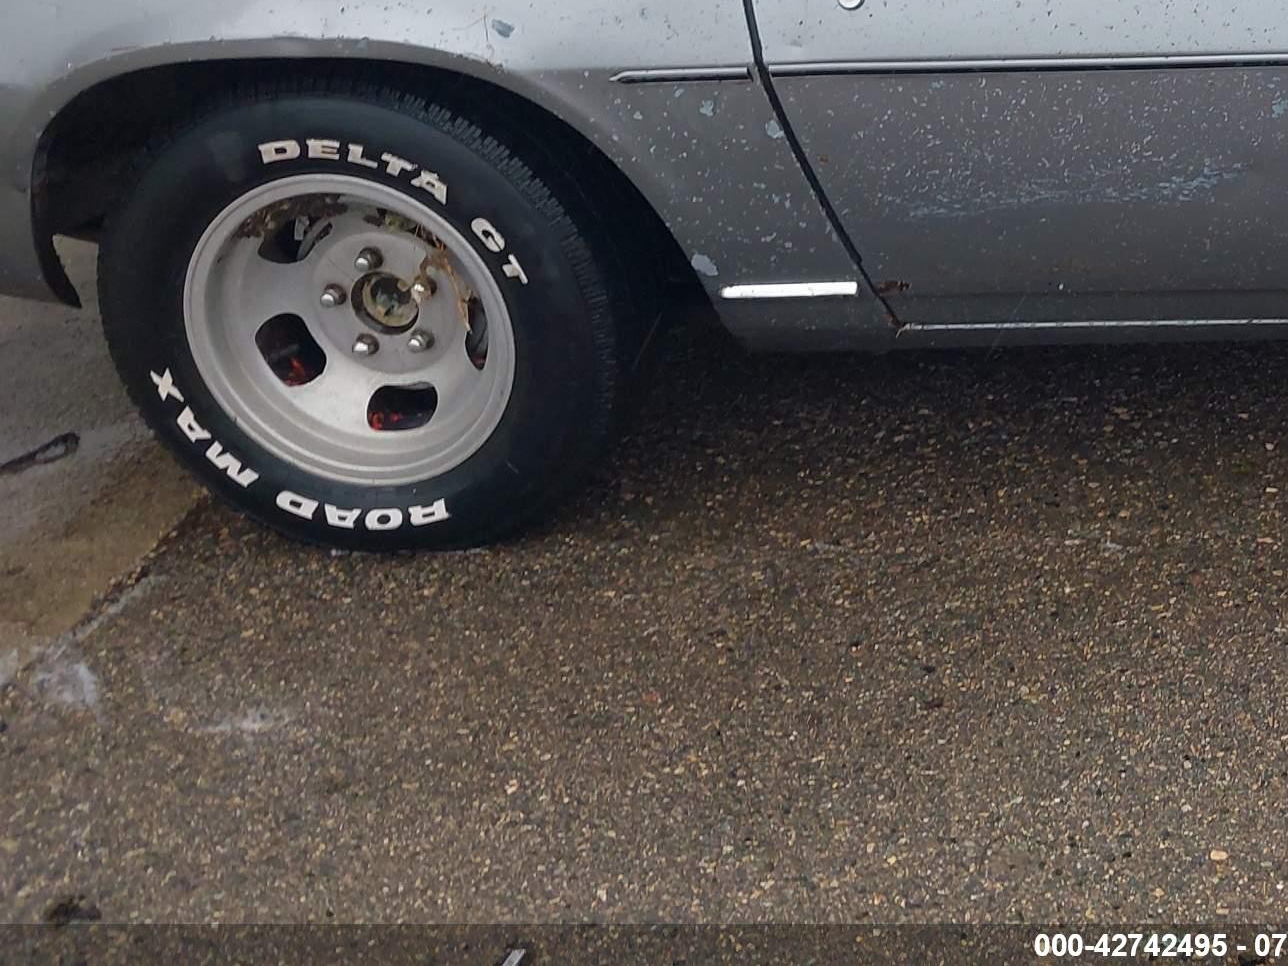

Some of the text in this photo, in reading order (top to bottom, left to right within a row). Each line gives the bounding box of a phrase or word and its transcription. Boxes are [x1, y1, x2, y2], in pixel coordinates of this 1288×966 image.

[257, 138, 530, 286] DELTA GT
[149, 366, 450, 531] ROAD MAX
